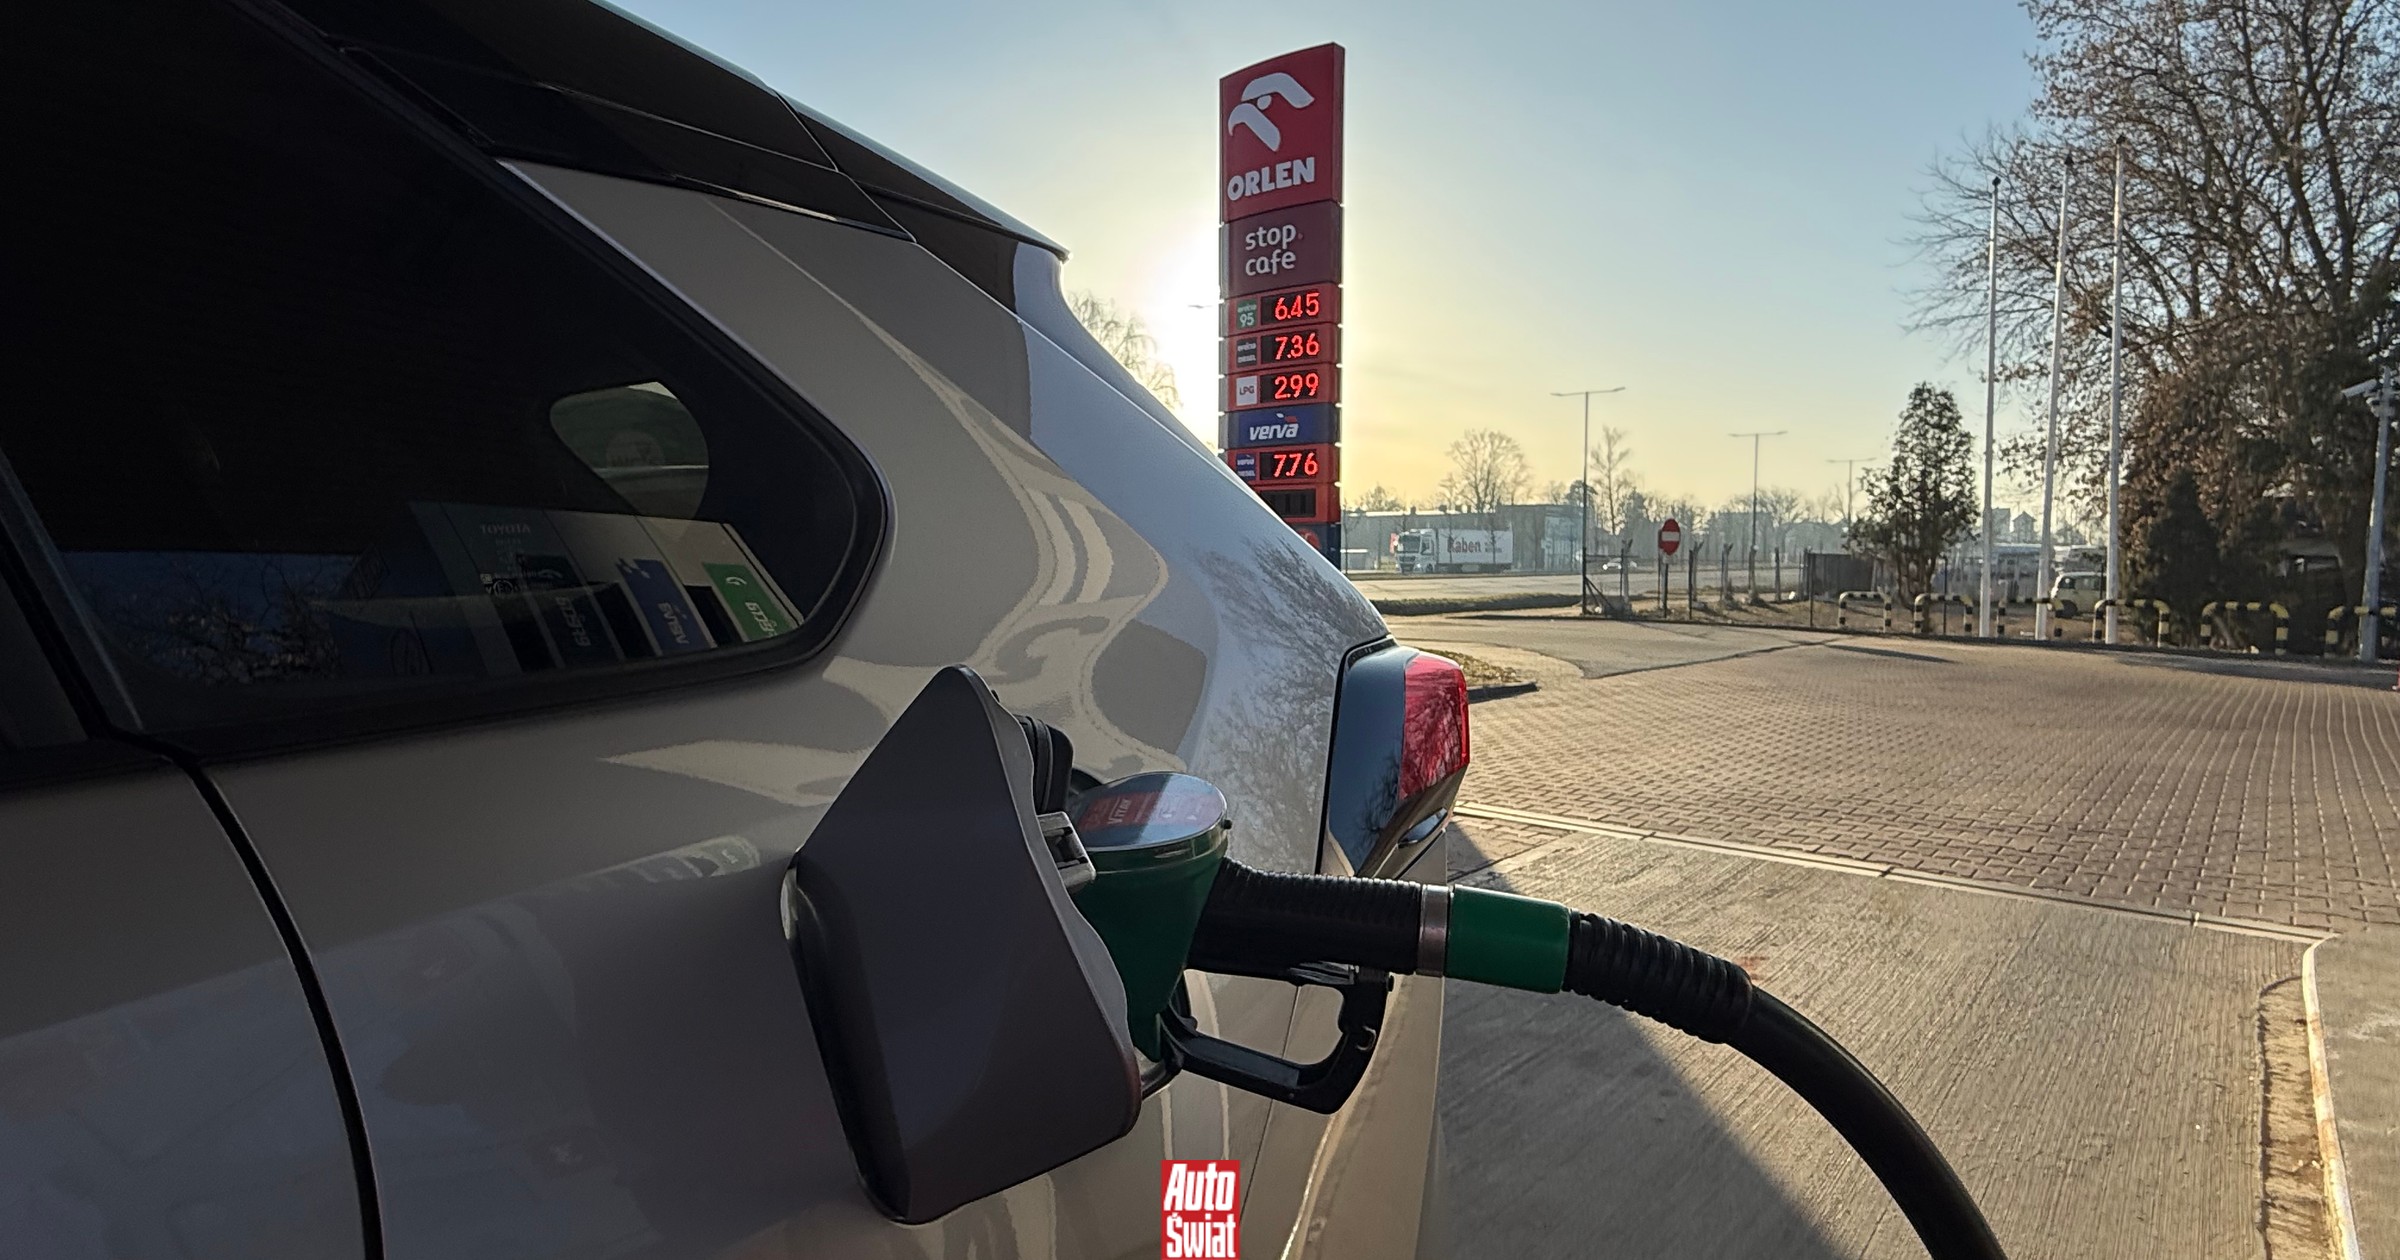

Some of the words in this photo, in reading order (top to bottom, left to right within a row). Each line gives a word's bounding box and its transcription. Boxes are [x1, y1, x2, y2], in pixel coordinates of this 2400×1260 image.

[1227, 156, 1315, 201] ORLEN
[1245, 224, 1297, 251] stop
[1245, 248, 1297, 276] cafe
[1239, 313, 1254, 327] 95
[1274, 292, 1320, 321] 6.45
[1275, 332, 1320, 360] 7.36
[1239, 385, 1255, 395] LPG
[1274, 372, 1319, 400] 2.99
[1249, 423, 1299, 440] verva
[1273, 452, 1319, 478] 7.76
[480, 524, 531, 535] TOYOTA
